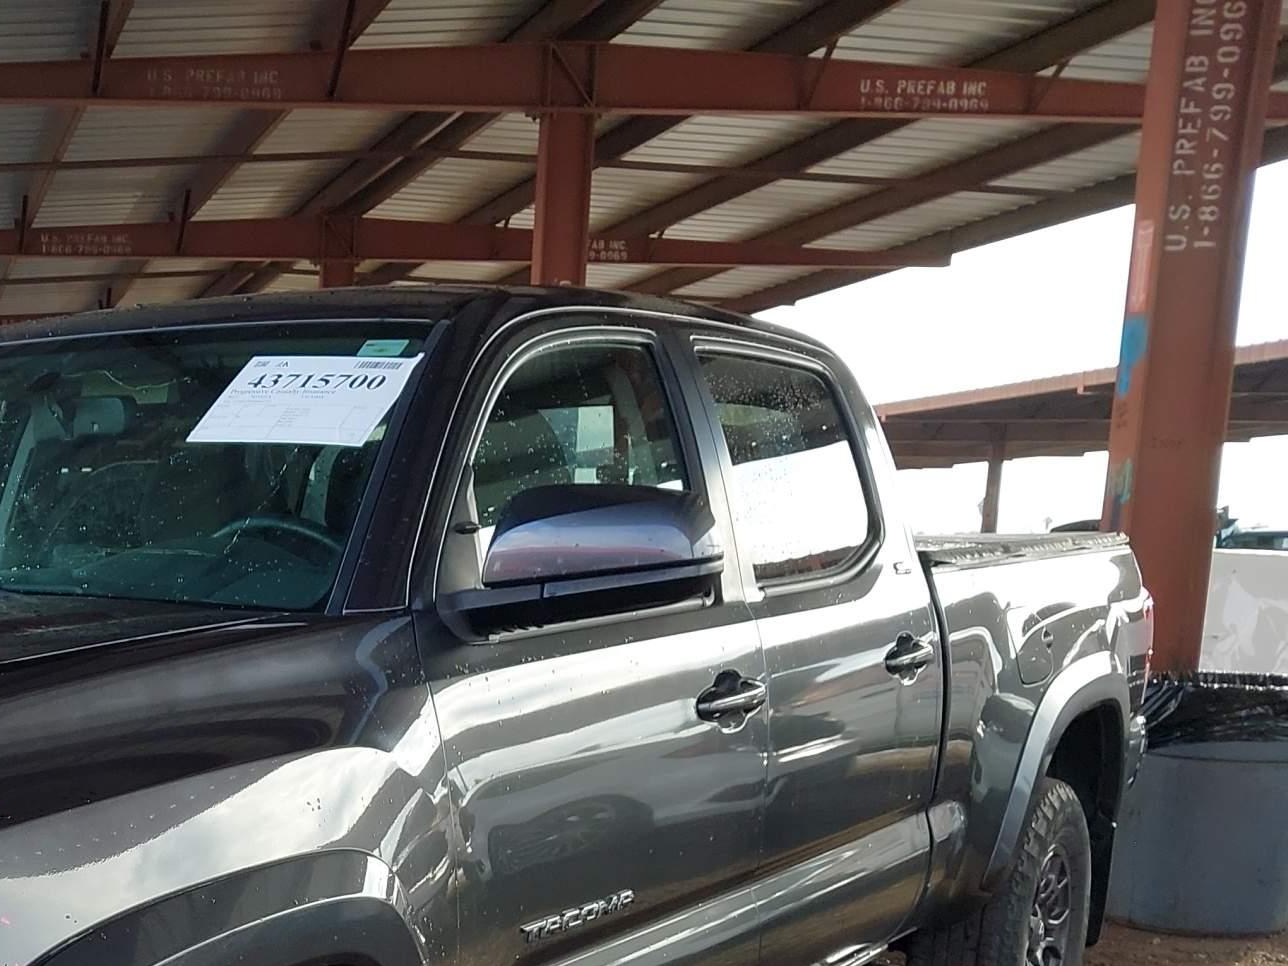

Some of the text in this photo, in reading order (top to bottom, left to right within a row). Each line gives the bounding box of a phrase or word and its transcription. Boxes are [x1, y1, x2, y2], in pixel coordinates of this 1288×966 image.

[860, 79, 988, 97] U.S. PREFAB INC
[1164, 0, 1218, 252] U.S. PREFAB IN
[248, 373, 387, 390] 43715700
[520, 889, 635, 943] TACOMA
